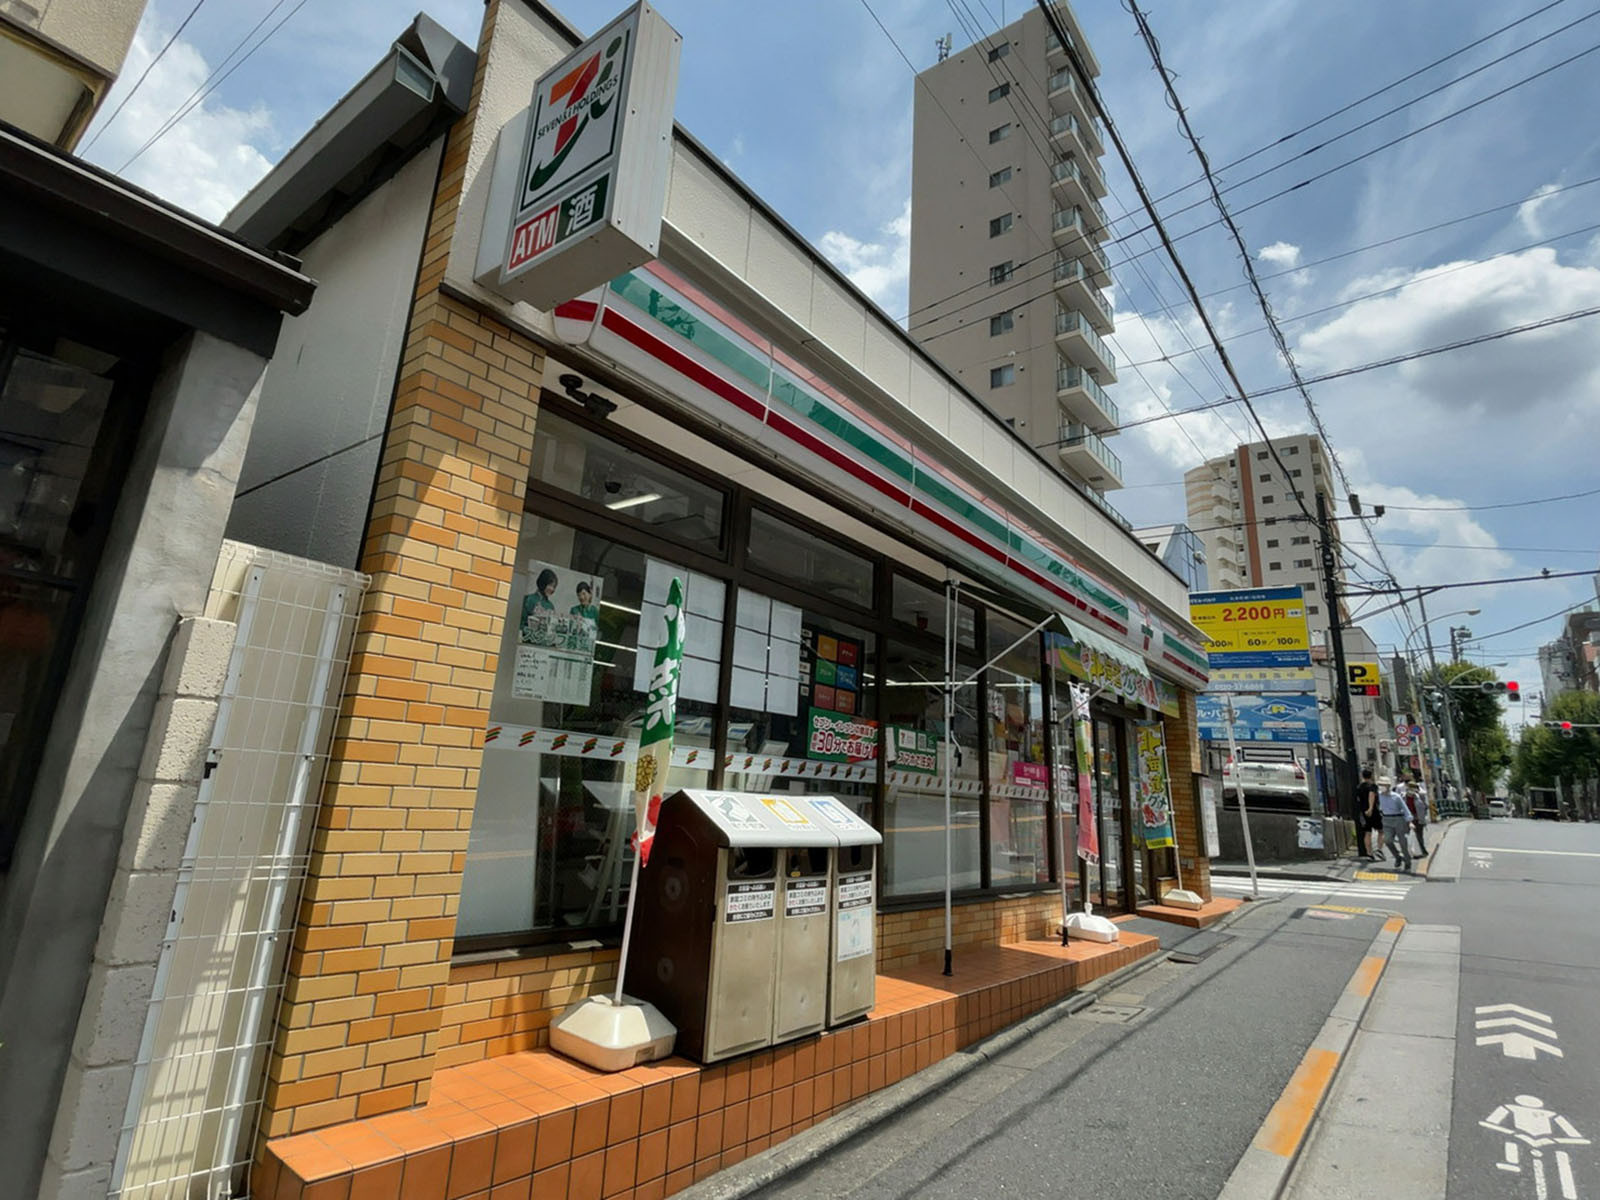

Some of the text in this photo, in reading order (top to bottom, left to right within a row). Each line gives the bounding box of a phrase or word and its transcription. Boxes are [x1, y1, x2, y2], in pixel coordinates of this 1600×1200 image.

[573, 75, 619, 116] HOLDINGS
[565, 184, 598, 236] 酒
[512, 211, 557, 264] ATM
[1222, 606, 1285, 622] 2,200円
[1348, 664, 1367, 683] P
